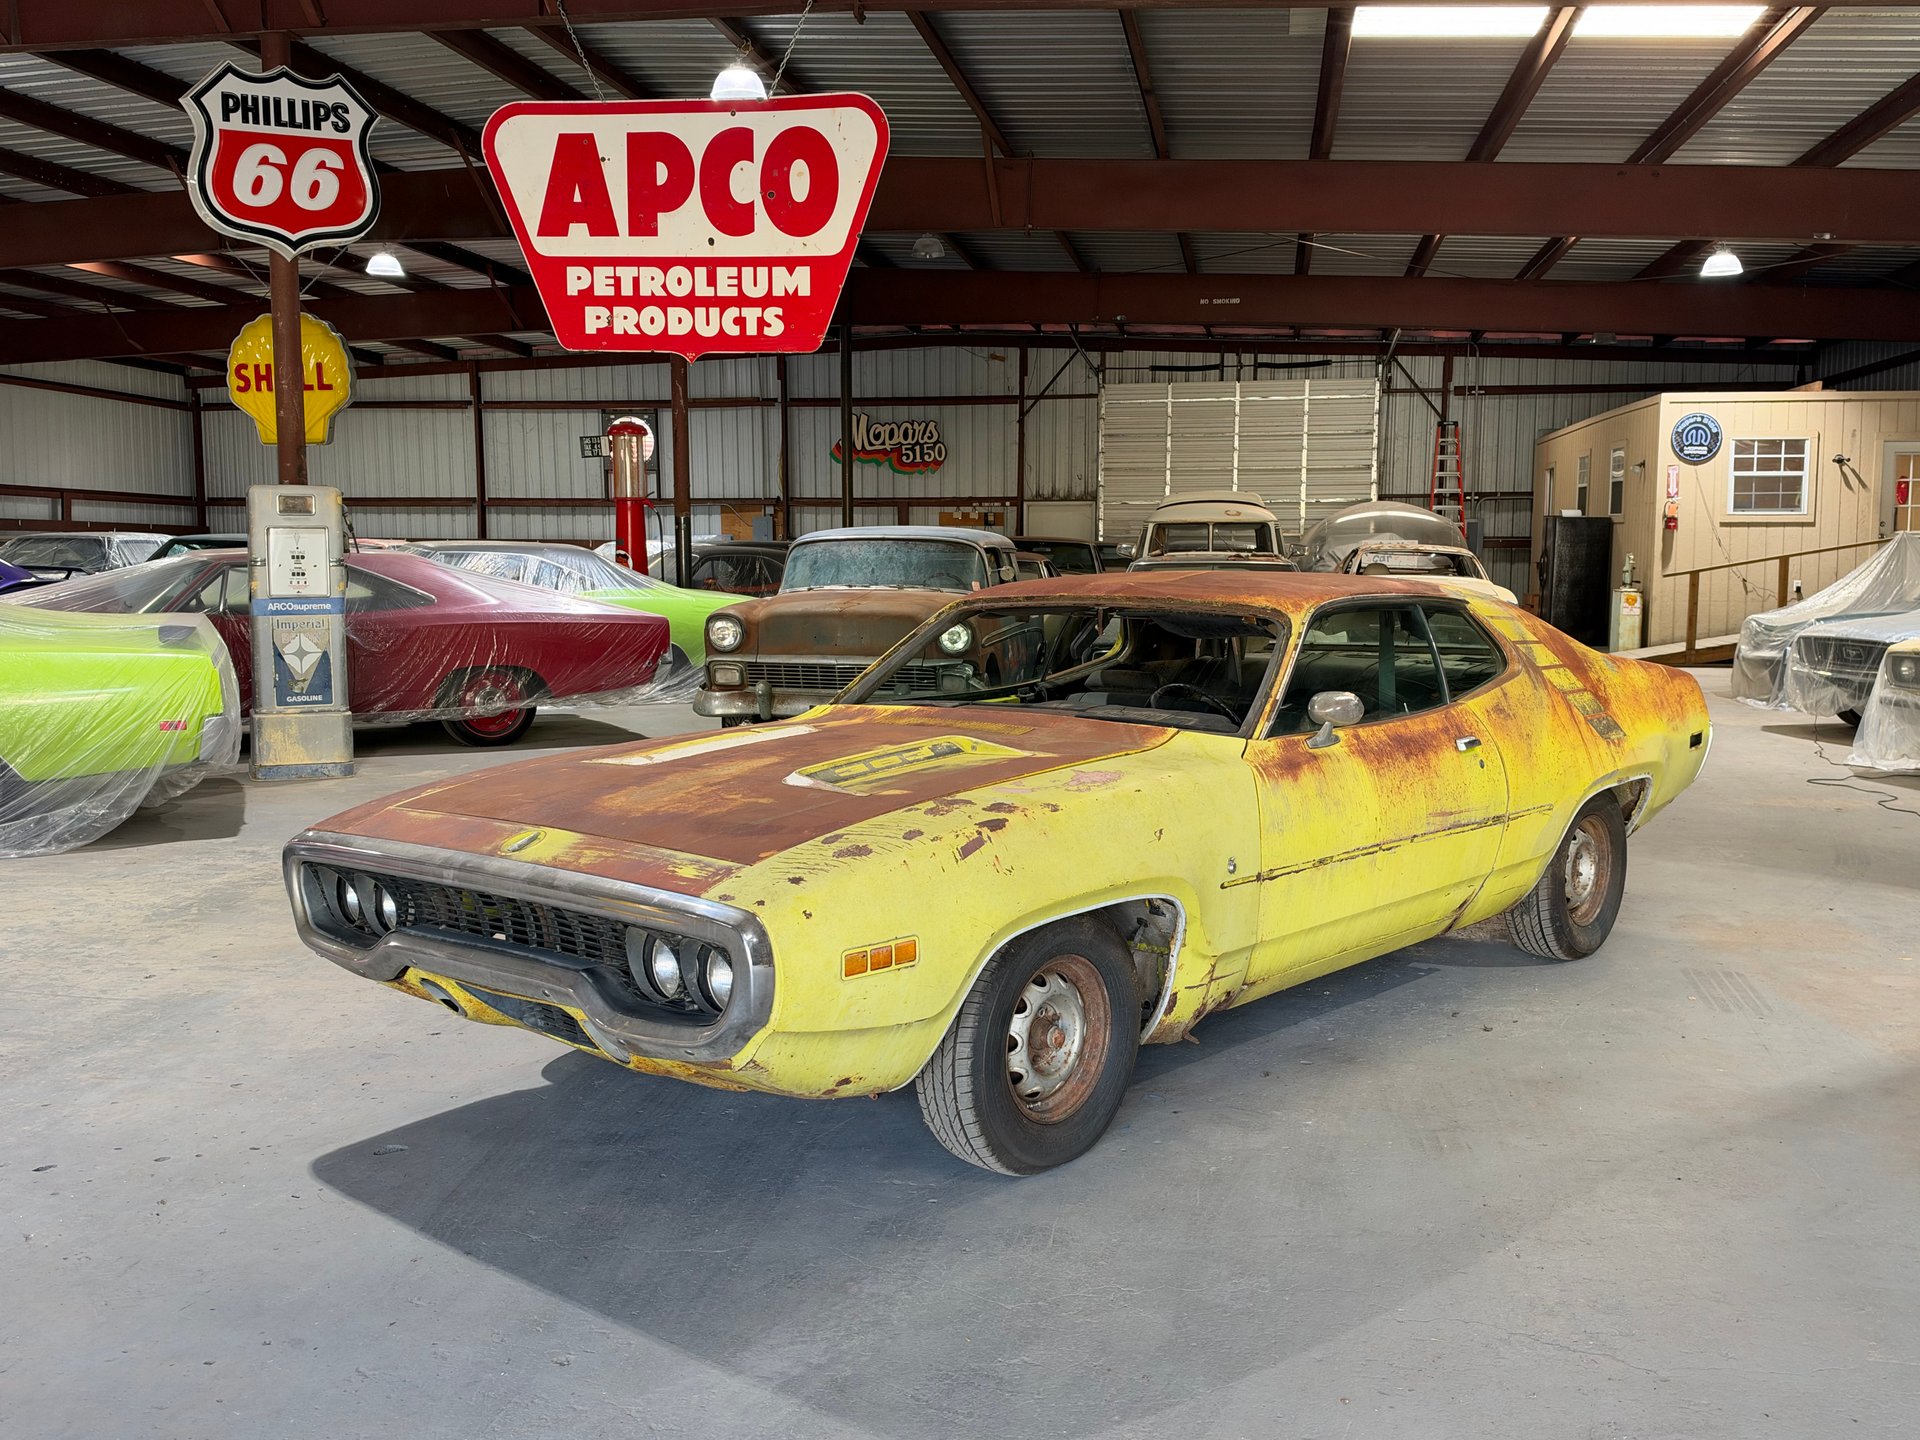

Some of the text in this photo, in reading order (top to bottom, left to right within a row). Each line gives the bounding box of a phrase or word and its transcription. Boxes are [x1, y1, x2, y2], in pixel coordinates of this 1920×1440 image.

[221, 91, 350, 133] PHILLIPS
[232, 143, 345, 211] 66
[537, 126, 839, 237] APCO
[566, 265, 811, 298] PETROLEUM
[1212, 297, 1241, 305] SMOKING
[584, 305, 785, 337] PRODUCTS
[234, 362, 334, 393] SHL
[840, 411, 939, 451] Mopars
[901, 442, 946, 464] 5150
[1372, 554, 1393, 563] car
[267, 602, 332, 611] ARCOsupreme
[276, 618, 325, 631] Imperial
[286, 694, 323, 702] GASOLINE
